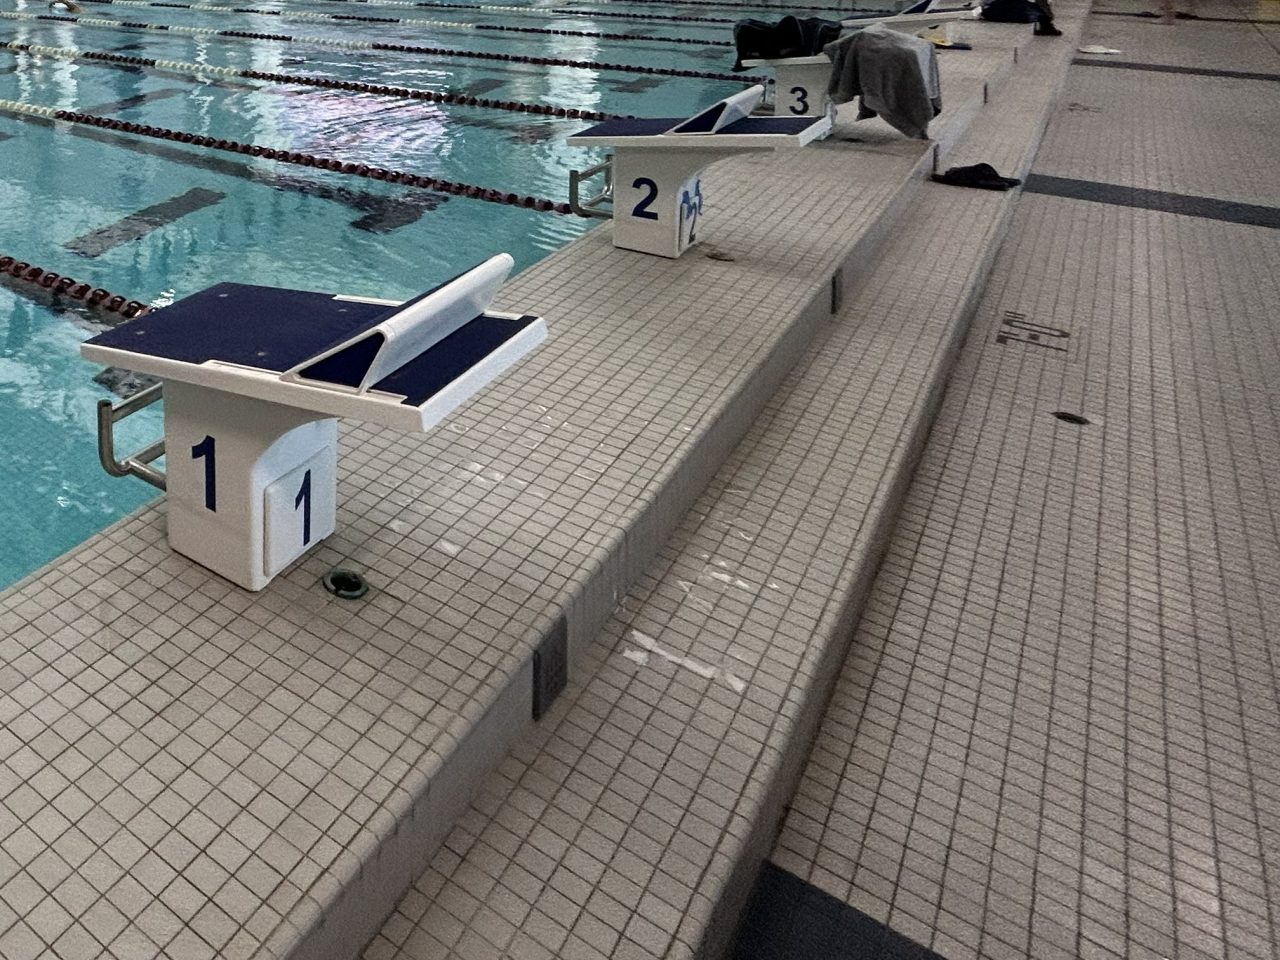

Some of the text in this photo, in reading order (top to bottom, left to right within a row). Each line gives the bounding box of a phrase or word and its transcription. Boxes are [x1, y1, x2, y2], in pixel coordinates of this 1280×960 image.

[789, 86, 810, 116] 3
[631, 177, 659, 221] 2
[192, 435, 216, 513] 1
[295, 469, 311, 546] 1
